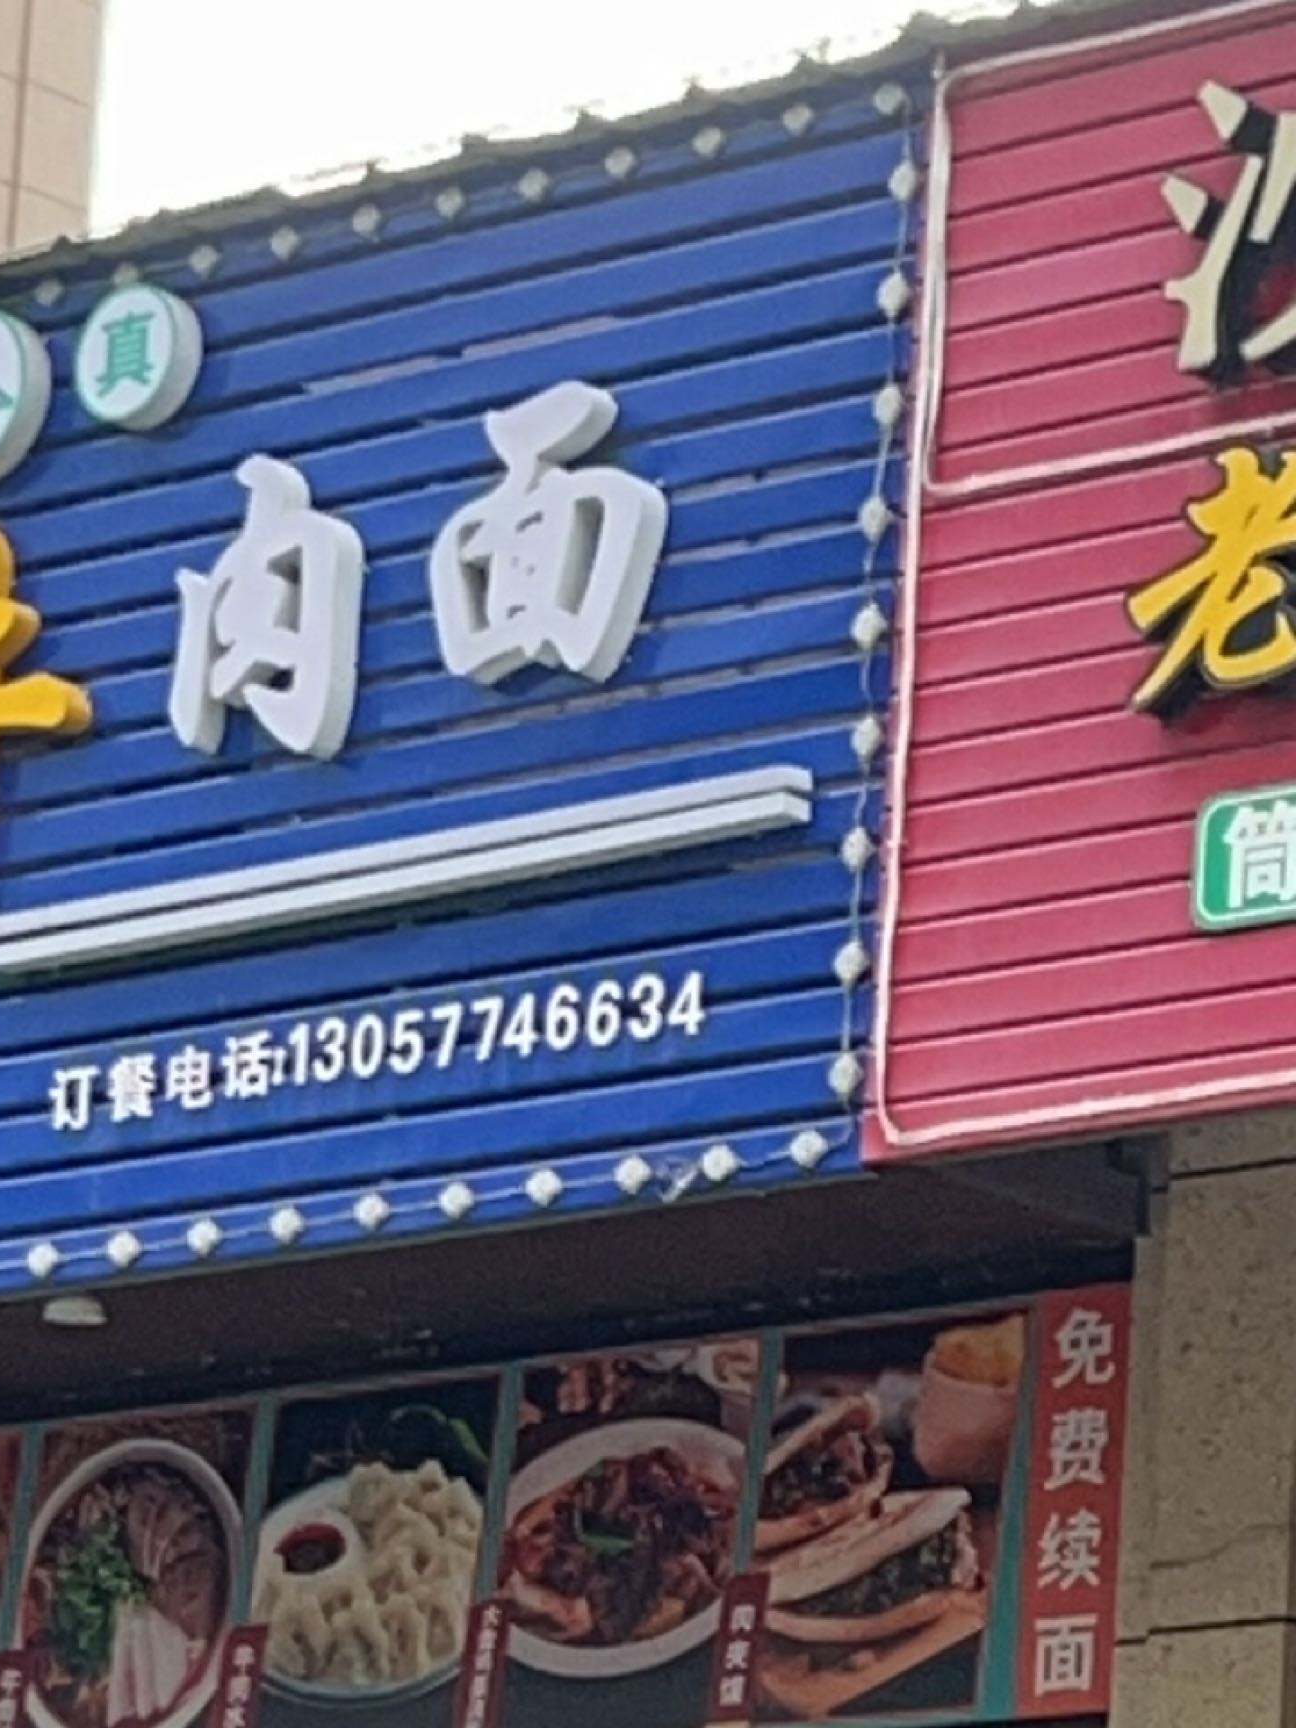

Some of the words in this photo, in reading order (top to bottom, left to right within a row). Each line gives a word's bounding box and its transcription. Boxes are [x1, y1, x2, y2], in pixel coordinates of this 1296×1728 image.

[95, 310, 156, 398] 真
[1034, 1307, 1117, 1697] 免费续面
